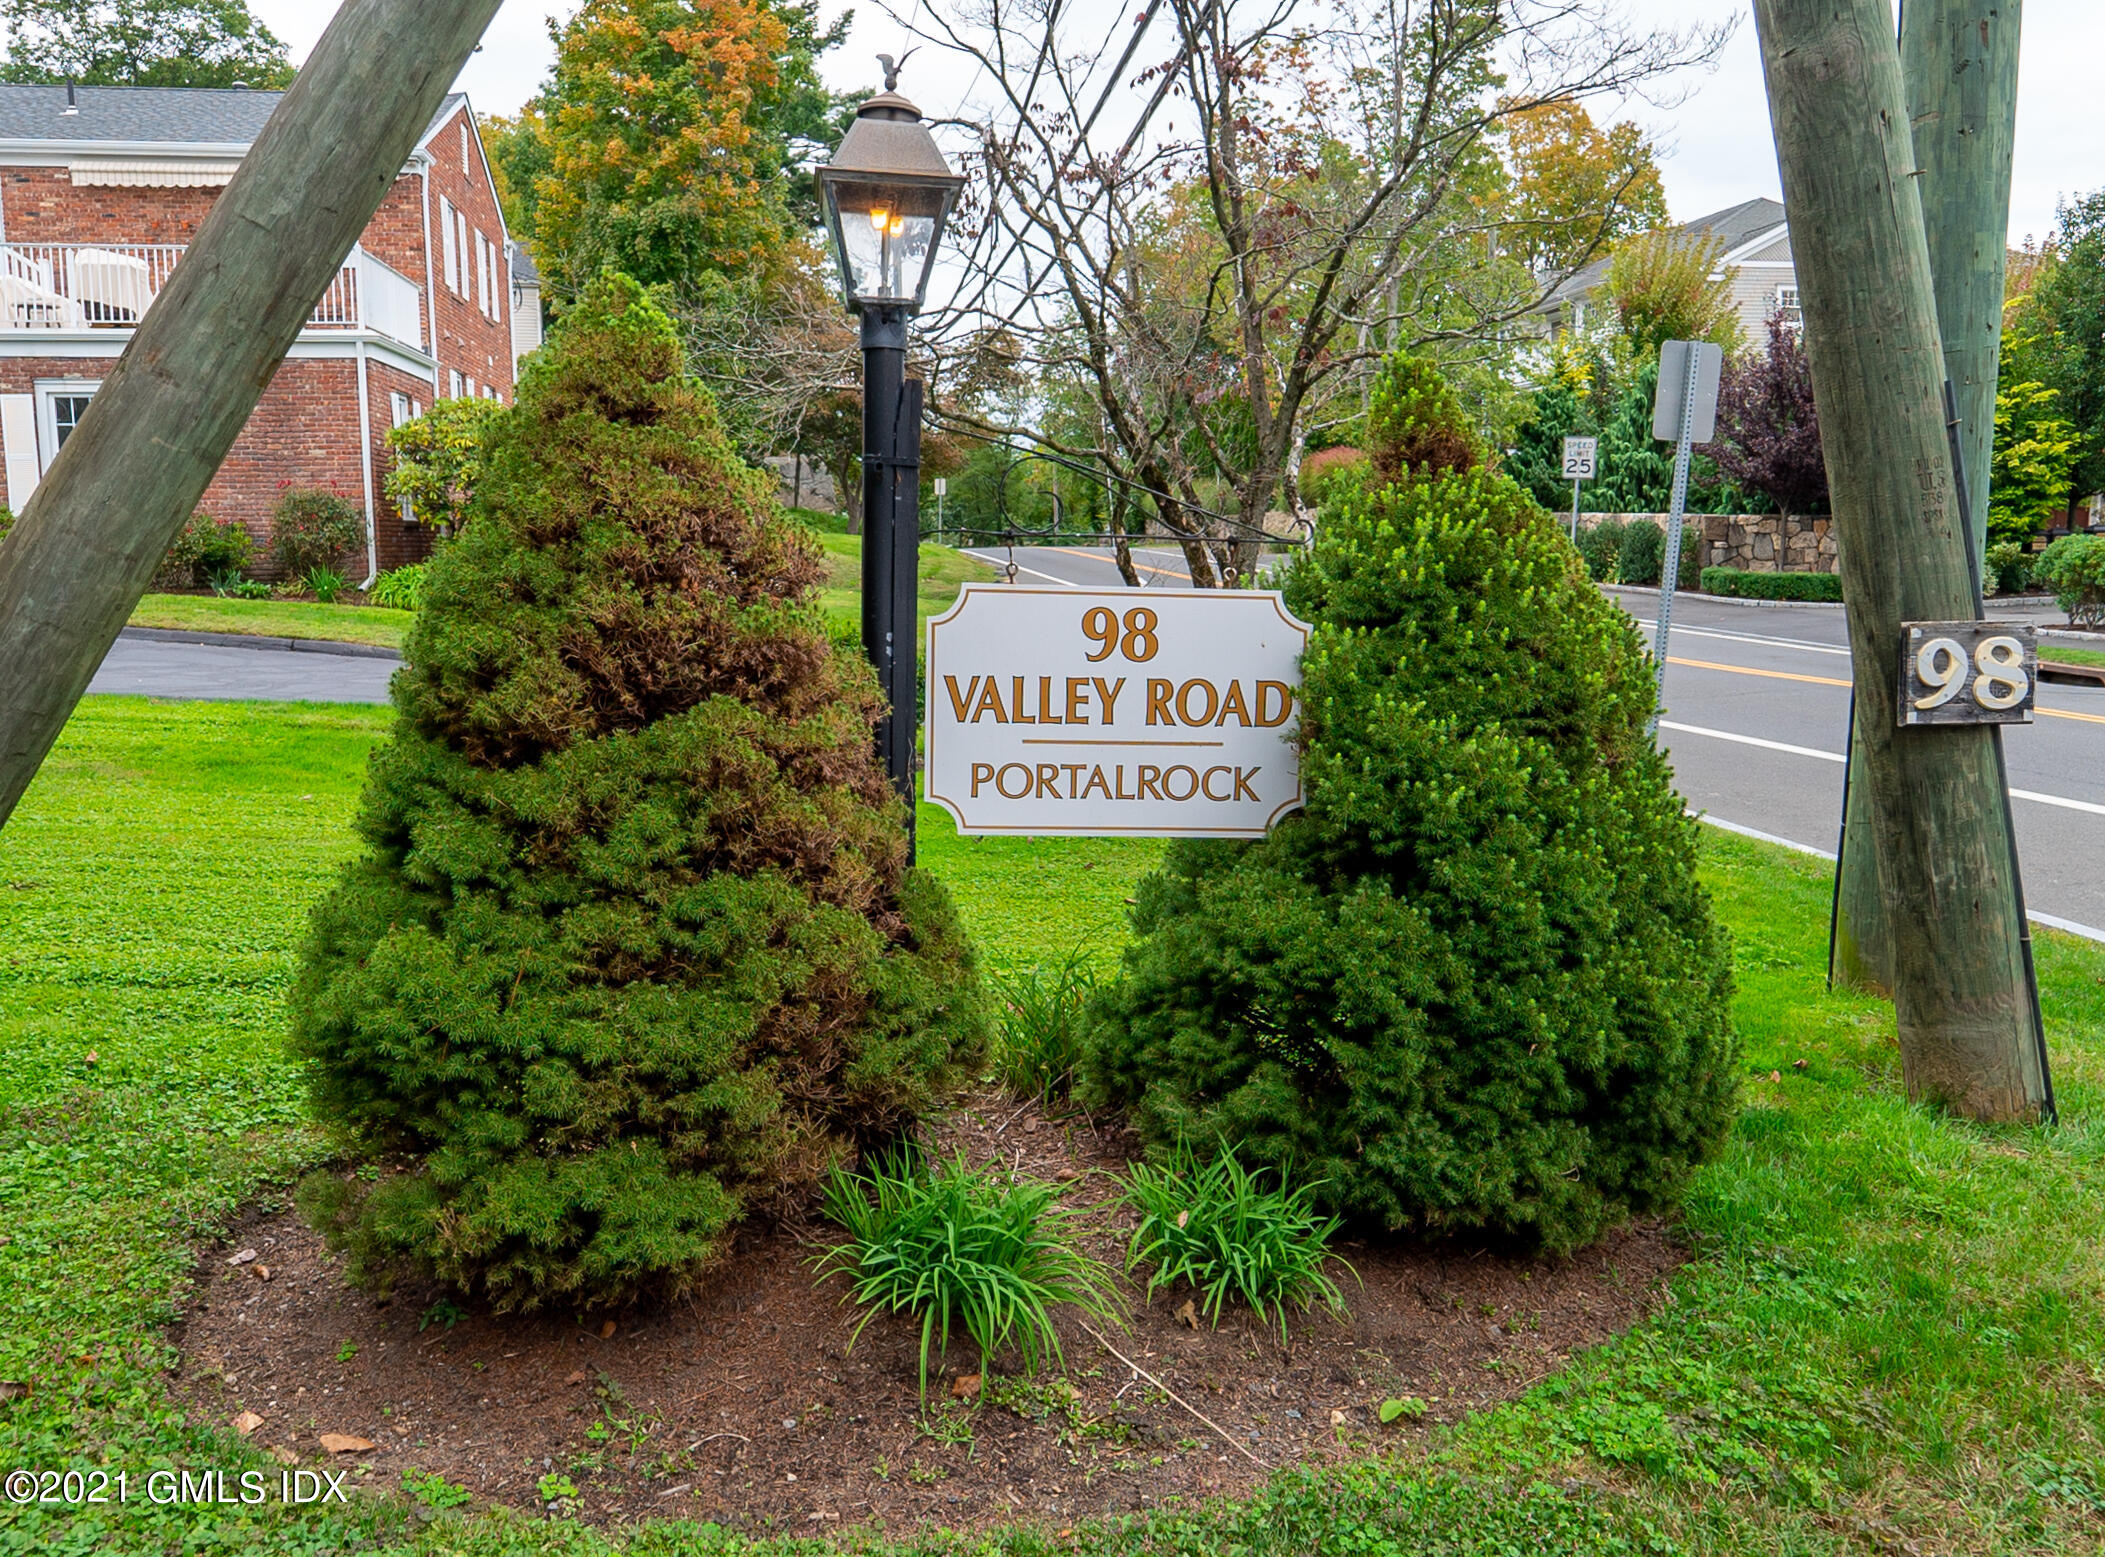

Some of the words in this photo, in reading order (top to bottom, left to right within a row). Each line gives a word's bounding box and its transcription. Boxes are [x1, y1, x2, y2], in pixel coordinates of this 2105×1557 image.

[1566, 458, 1591, 474] 25
[1567, 441, 1593, 449] SPEED
[1081, 606, 1159, 663] 98
[1914, 636, 2029, 711] 98
[943, 675, 1126, 726] VALLEY
[1145, 678, 1293, 728] ROAD
[970, 762, 1262, 802] PORTALROCK
